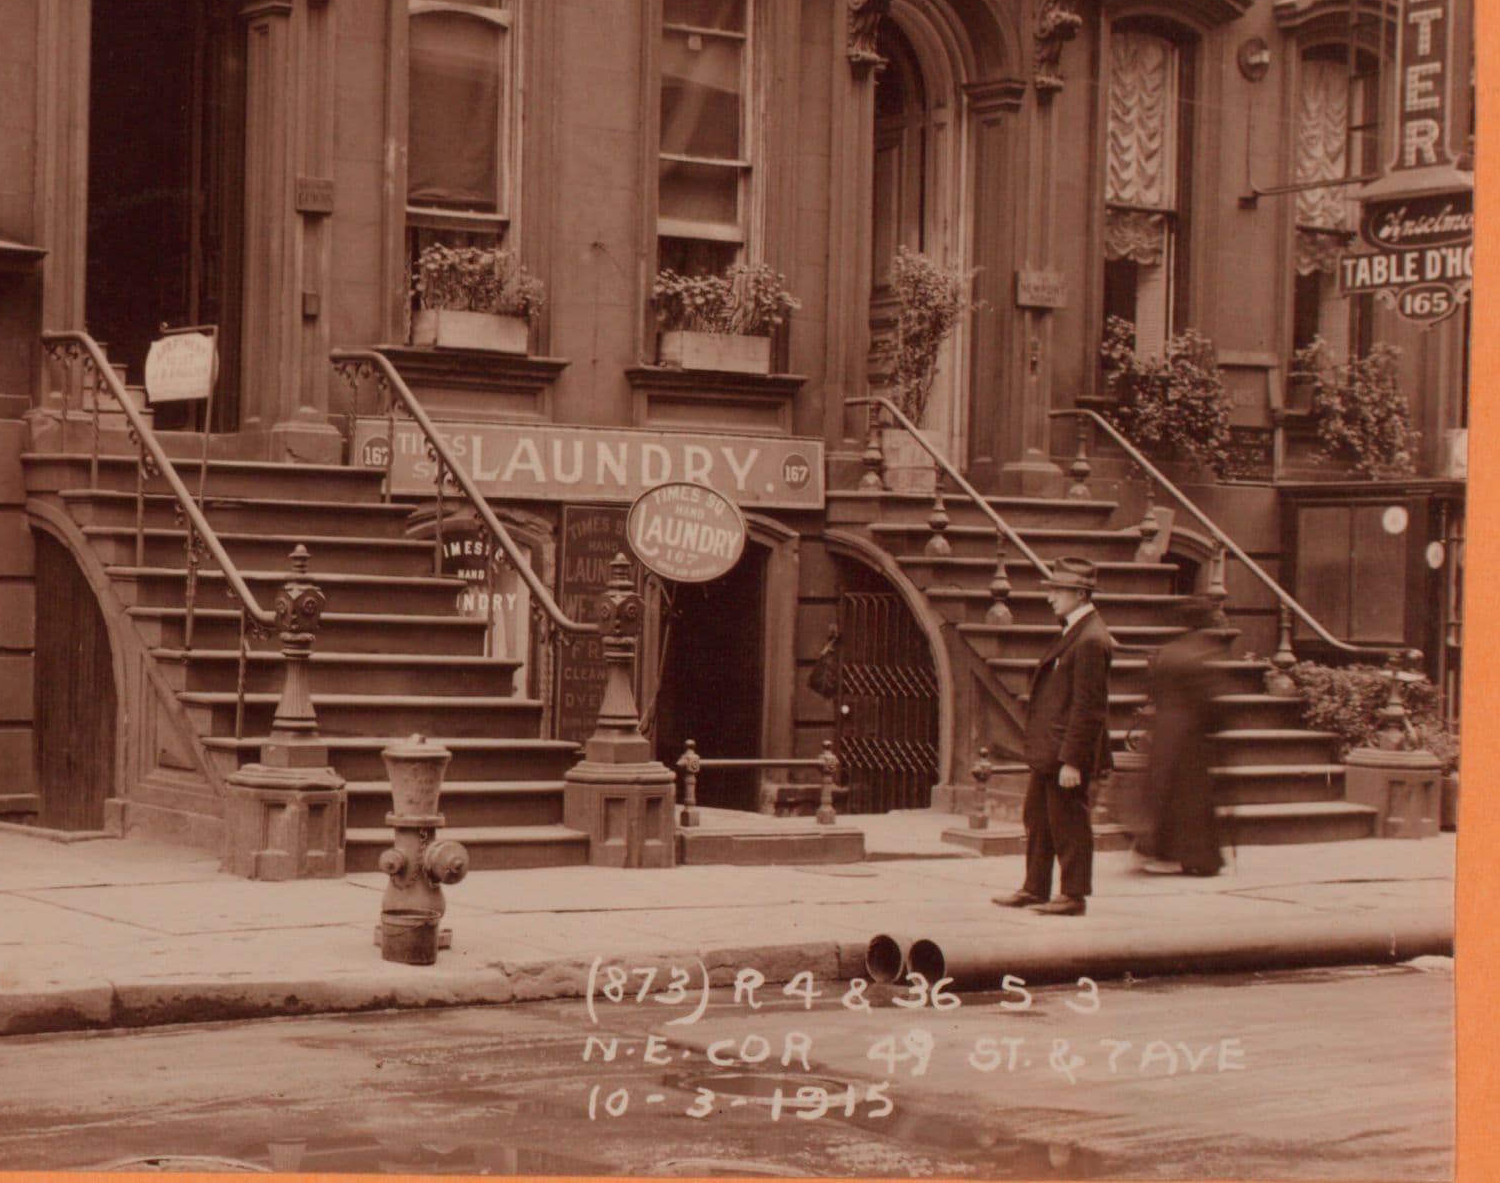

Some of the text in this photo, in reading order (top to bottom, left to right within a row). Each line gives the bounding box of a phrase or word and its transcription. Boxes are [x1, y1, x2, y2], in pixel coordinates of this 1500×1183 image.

[1342, 253, 1420, 288] TABLE
[1404, 291, 1448, 315] 165
[784, 462, 809, 483] 167
[651, 484, 701, 506] TIMES
[635, 503, 741, 559] LAUNDRY
[443, 540, 483, 559] IMES
[457, 568, 486, 581] HAND
